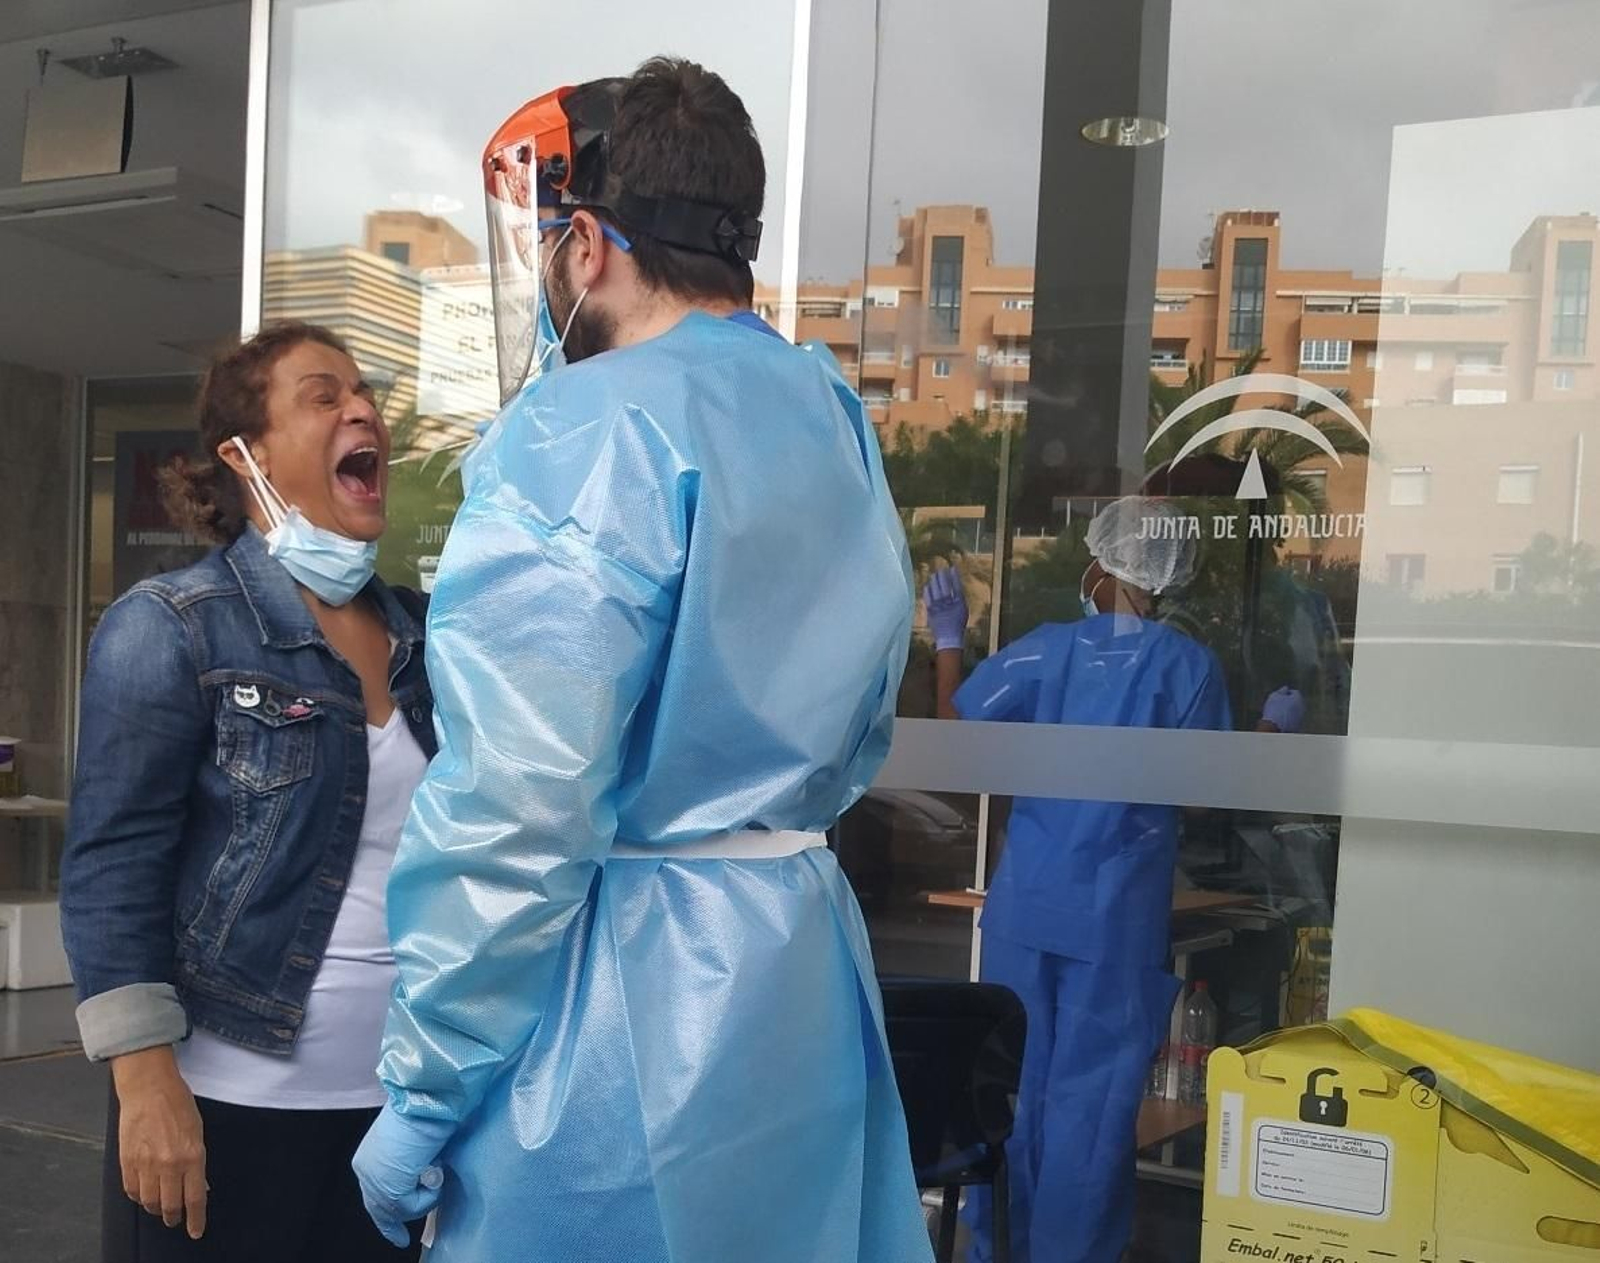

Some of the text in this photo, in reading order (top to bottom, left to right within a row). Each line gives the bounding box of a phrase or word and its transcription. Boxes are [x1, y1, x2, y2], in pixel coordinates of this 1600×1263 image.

[416, 524, 451, 544] JUNT
[1135, 513, 1367, 540] JUNTA DE ANDALUCIA
[1420, 1088, 1430, 1105] 2
[1227, 1238, 1315, 1263] Embal.net
